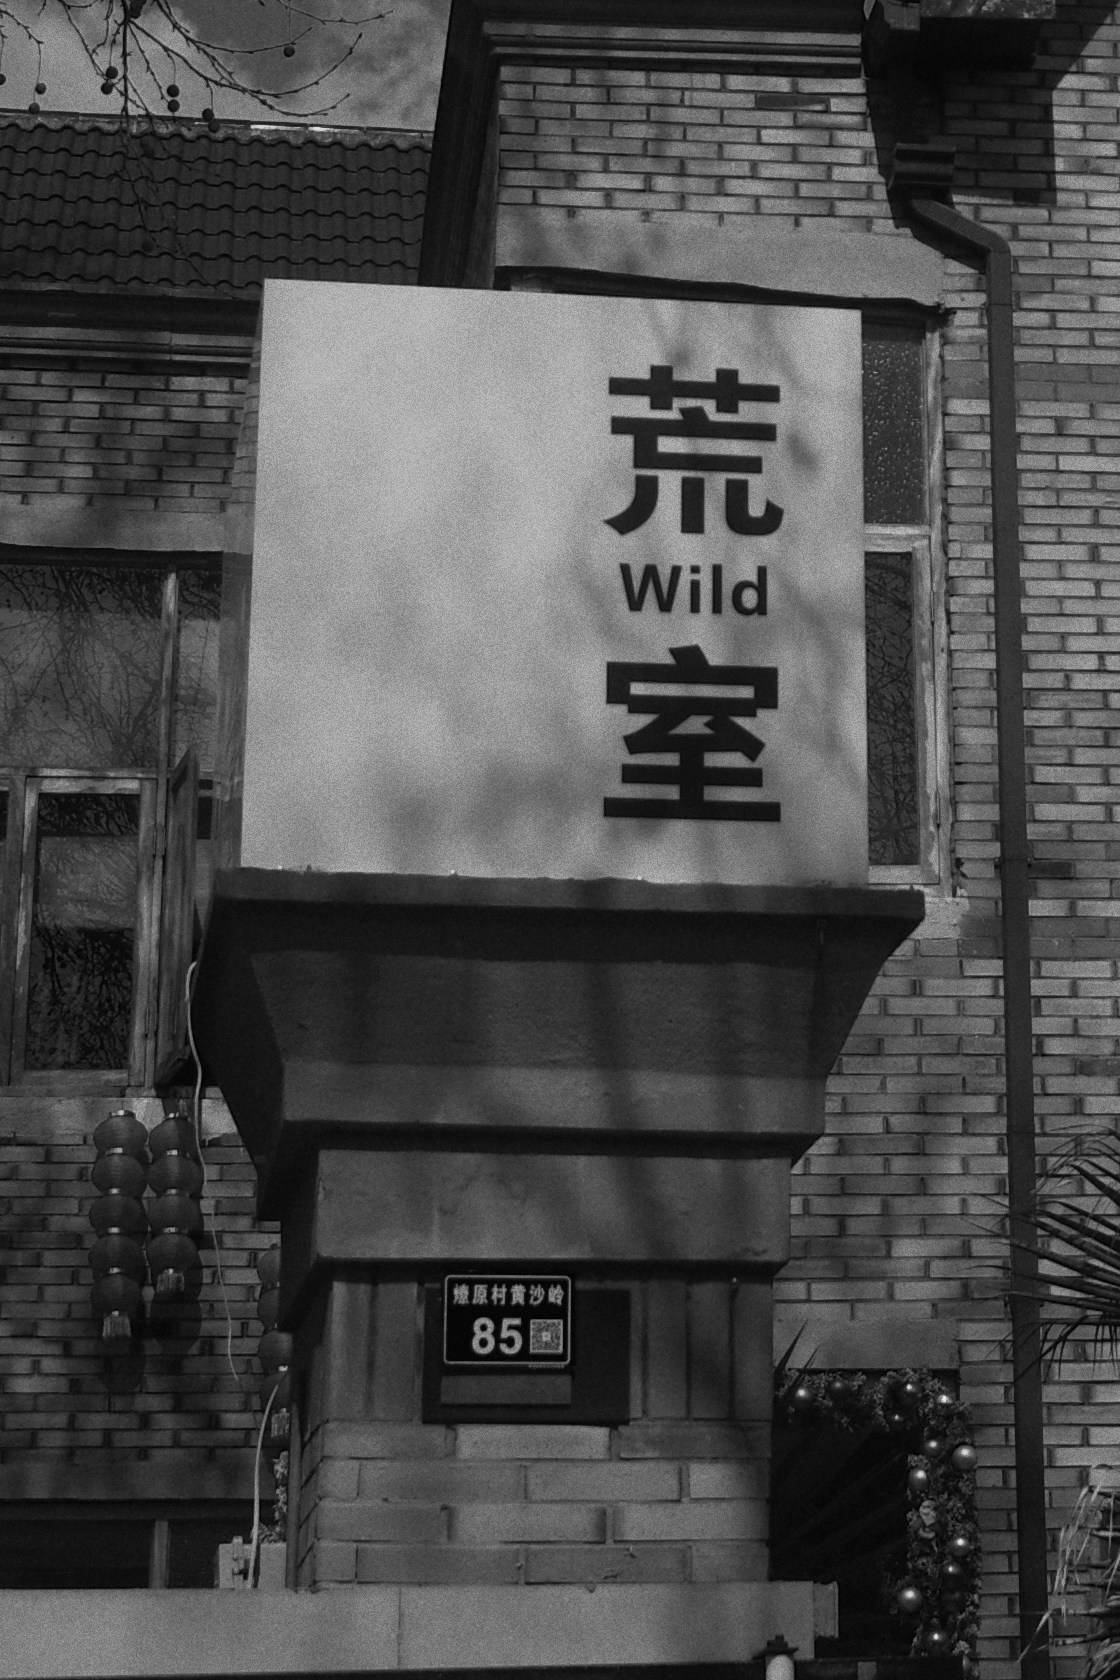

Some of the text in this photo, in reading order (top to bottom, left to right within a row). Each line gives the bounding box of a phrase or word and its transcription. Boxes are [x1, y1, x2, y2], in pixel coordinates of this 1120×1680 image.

[604, 365, 784, 536] 荒
[620, 563, 768, 616] Wild
[603, 644, 782, 823] 室
[471, 1317, 523, 1355] 85
